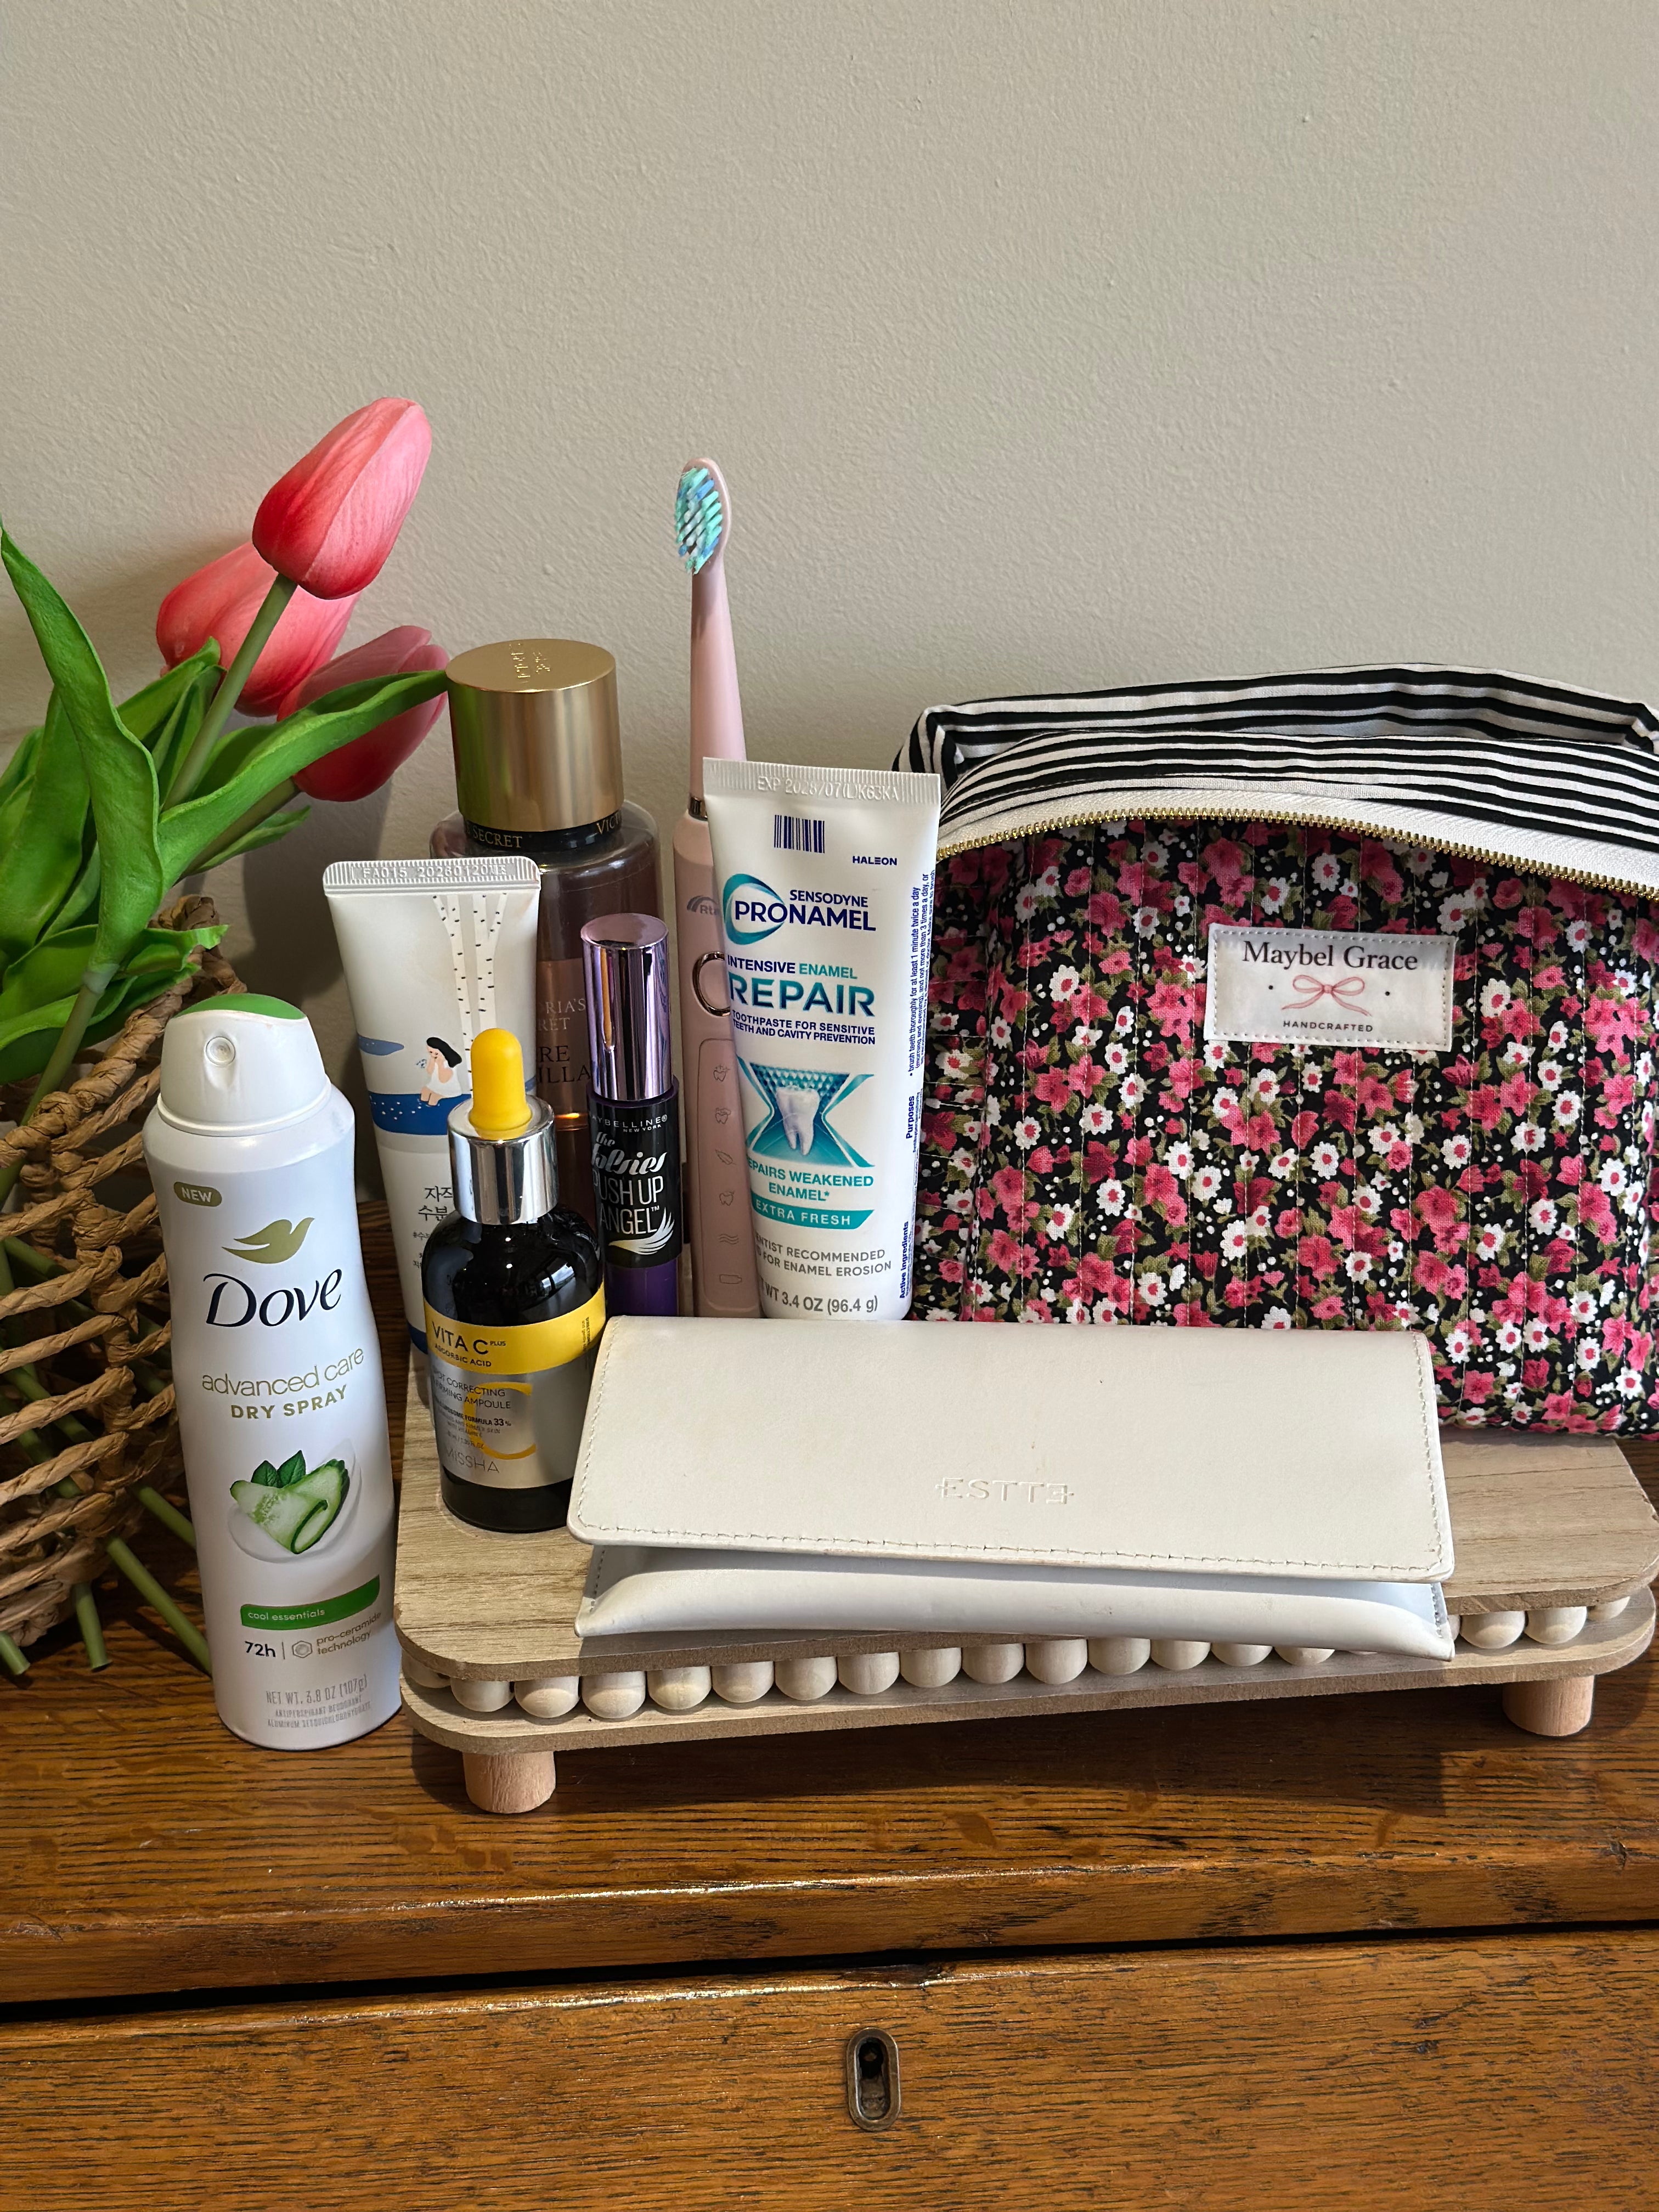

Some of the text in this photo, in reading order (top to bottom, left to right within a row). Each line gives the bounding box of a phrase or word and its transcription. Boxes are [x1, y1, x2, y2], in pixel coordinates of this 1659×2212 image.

[758, 776, 781, 792] EXP
[473, 825, 522, 848] SECRET
[852, 856, 898, 866] HALEON
[789, 889, 868, 908] SENSODYNE
[911, 887, 921, 900] day
[735, 900, 877, 932] PRONAMEL
[911, 928, 919, 952] minute
[727, 955, 858, 979] INTENSIVE ENAMEL
[1243, 941, 1418, 970] Maybel Grace
[728, 971, 876, 1017] REPAIR
[911, 978, 917, 986] at
[545, 998, 586, 1014] RIA'S
[732, 1009, 875, 1036] TOOTHPASTE FOR SENSITIVE
[733, 1018, 876, 1045] TEETH AND CAVITY PREVENTION
[1283, 1020, 1373, 1032] HANDCRAFTED
[539, 1045, 570, 1063] RE
[906, 1096, 915, 1139] Purposes
[596, 1131, 616, 1147] the
[592, 1169, 664, 1205] PUSH UP
[789, 1170, 874, 1187] WEAKENED
[182, 1187, 212, 1203] NEW
[755, 1200, 850, 1226] EXTRA FRESH
[763, 1251, 891, 1277] FOR ENAMEL EROSION
[787, 1246, 885, 1262] RECOMMENDED
[203, 1268, 342, 1327] Dove
[765, 1282, 779, 1301] WT
[782, 1291, 799, 1308] 3.4
[803, 1296, 823, 1312] OZ
[827, 1297, 861, 1315] (96.4
[866, 1295, 878, 1313] g)
[432, 1321, 469, 1352] VITA
[473, 1339, 488, 1355] C
[435, 1343, 467, 1363] ASCORBIC
[202, 1348, 364, 1397] advanced care
[447, 1378, 505, 1397] CORRECTING
[232, 1384, 348, 1419] DRY SPRAY
[464, 1397, 511, 1409] AMPOULE
[465, 1415, 492, 1425] FORMULA
[248, 1609, 325, 1620] cool essentials
[245, 1612, 381, 1657] 72h pro-ceramide
[318, 1631, 371, 1655] technology
[266, 1691, 281, 1704] NET
[285, 1692, 303, 1705] WT.
[325, 1686, 336, 1700] OZ
[340, 1674, 367, 1698] (107g)
